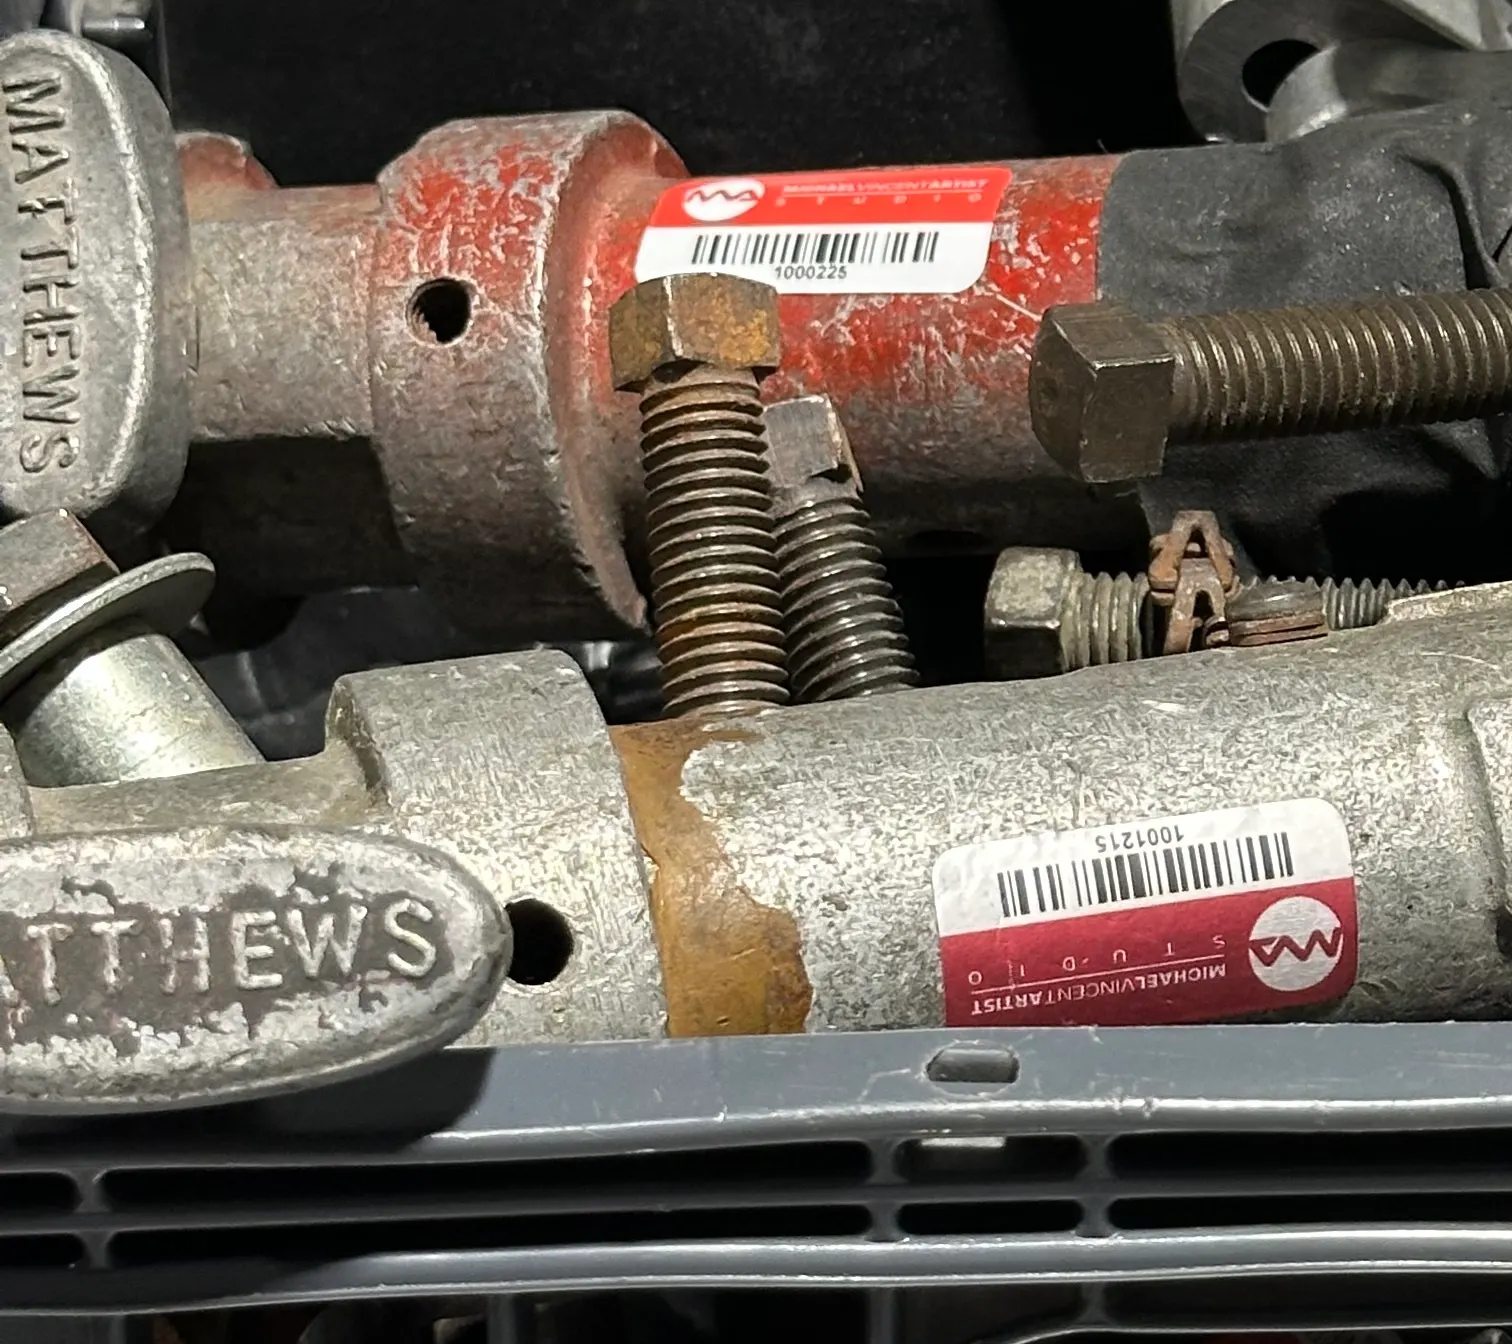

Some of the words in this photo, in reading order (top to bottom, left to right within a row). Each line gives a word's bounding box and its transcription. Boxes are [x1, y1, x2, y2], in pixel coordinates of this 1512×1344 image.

[2, 70, 82, 474] MATTHEWS
[774, 265, 848, 280] 1000225
[1095, 824, 1184, 853] 1001215
